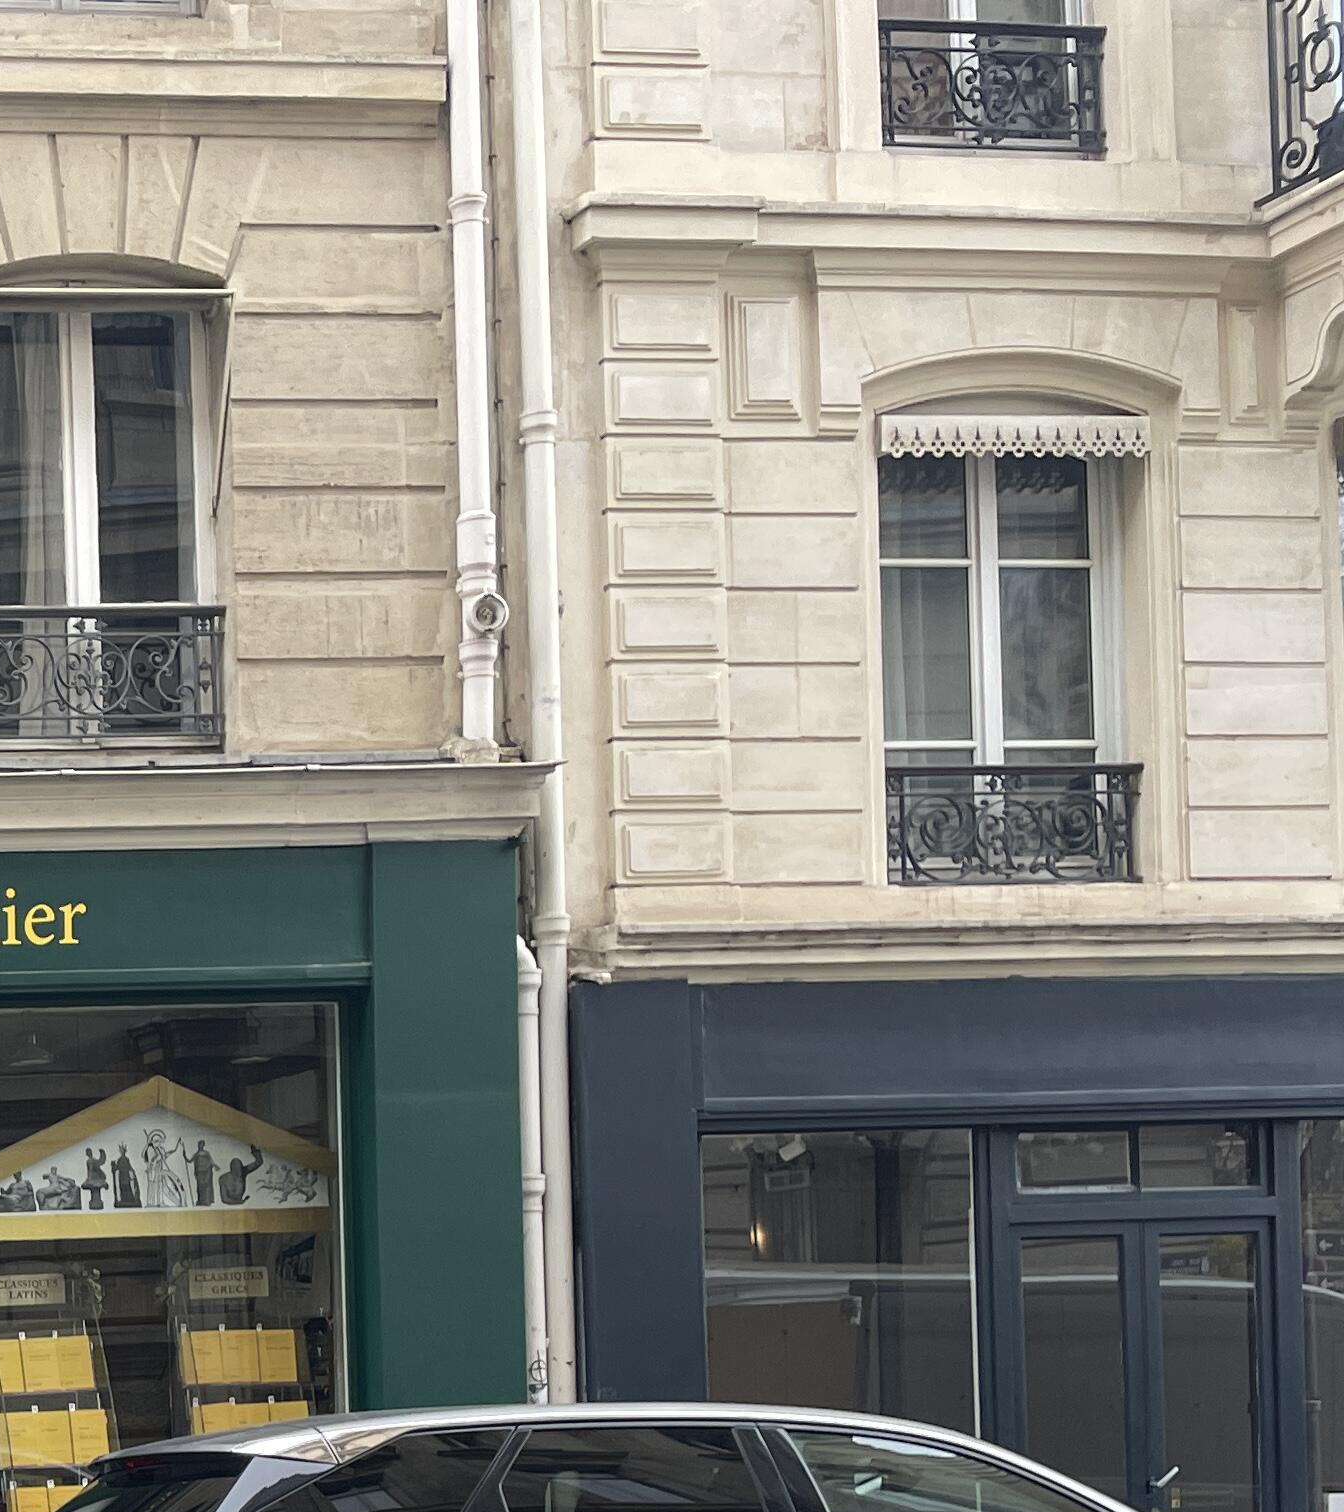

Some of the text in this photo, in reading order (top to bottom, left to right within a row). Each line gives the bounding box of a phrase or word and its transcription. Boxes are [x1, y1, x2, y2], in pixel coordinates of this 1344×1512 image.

[194, 1271, 264, 1282] CLASSIQUES
[211, 1284, 249, 1294] GRECS
[9, 1290, 48, 1300] LATINS
